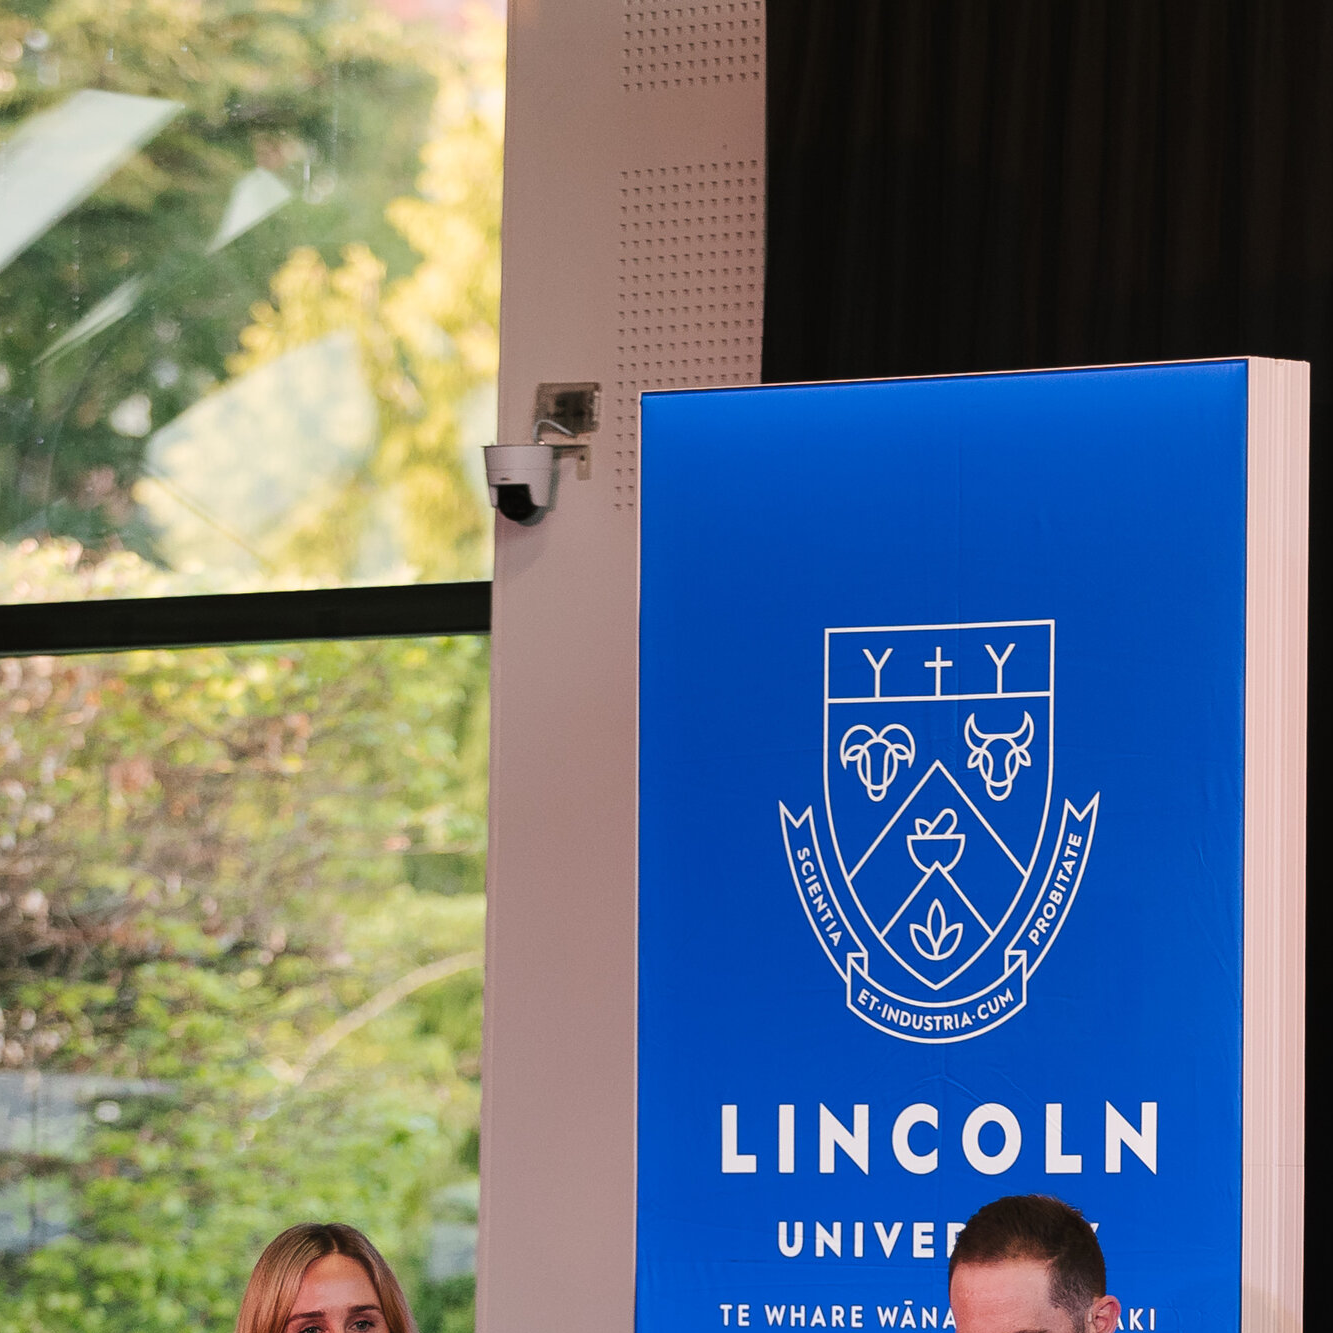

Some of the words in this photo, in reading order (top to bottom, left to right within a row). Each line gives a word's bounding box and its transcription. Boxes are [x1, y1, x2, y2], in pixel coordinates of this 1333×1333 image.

[797, 847, 843, 947] SCIENTIA
[1028, 832, 1083, 946] PROBITATE
[722, 1100, 1158, 1176] LINCOLN
[719, 1303, 751, 1328] TE
[764, 1304, 864, 1329] WHARE
[878, 1300, 957, 1330] WĀNA
